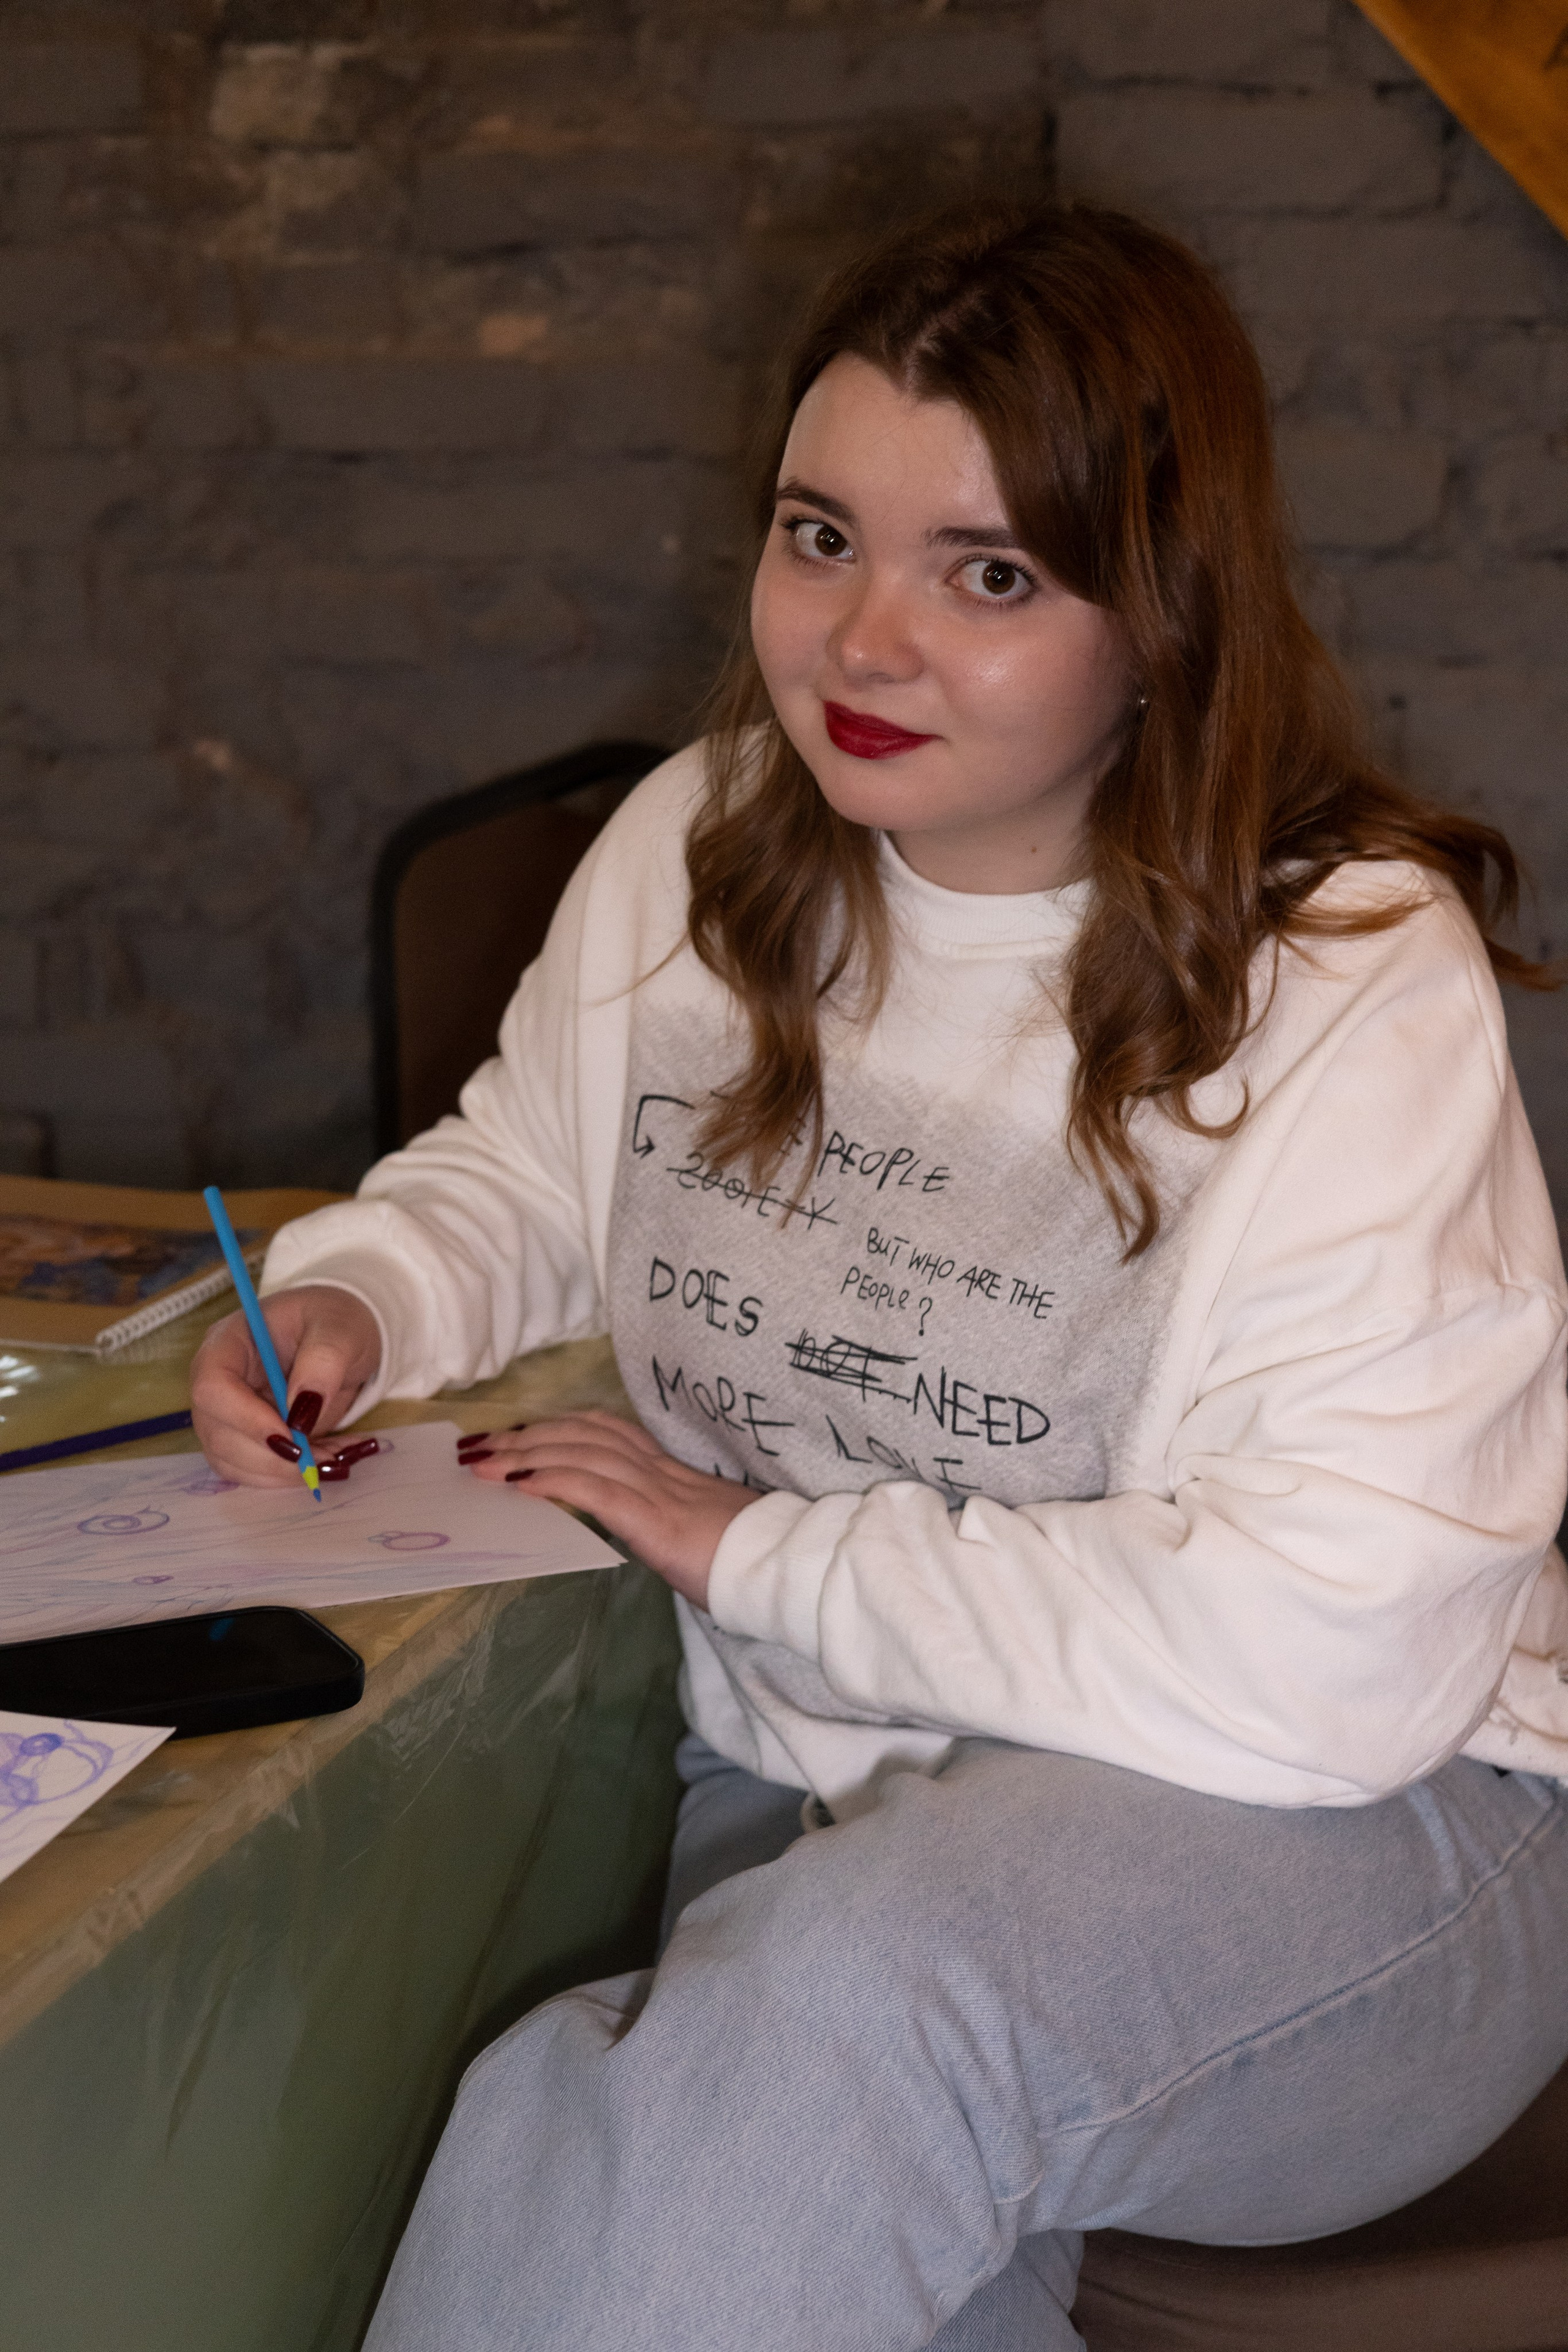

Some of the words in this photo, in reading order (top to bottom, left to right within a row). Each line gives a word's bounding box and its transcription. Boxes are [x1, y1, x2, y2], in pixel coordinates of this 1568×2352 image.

[818, 1130, 950, 1193] PEOPLE
[908, 1246, 956, 1286] WHO
[957, 1265, 1002, 1300] ARE
[1009, 1278, 1055, 1319] THE
[650, 1256, 764, 1337] DOES
[914, 1365, 1051, 1446] NEED
[652, 1354, 795, 1457] MORE
